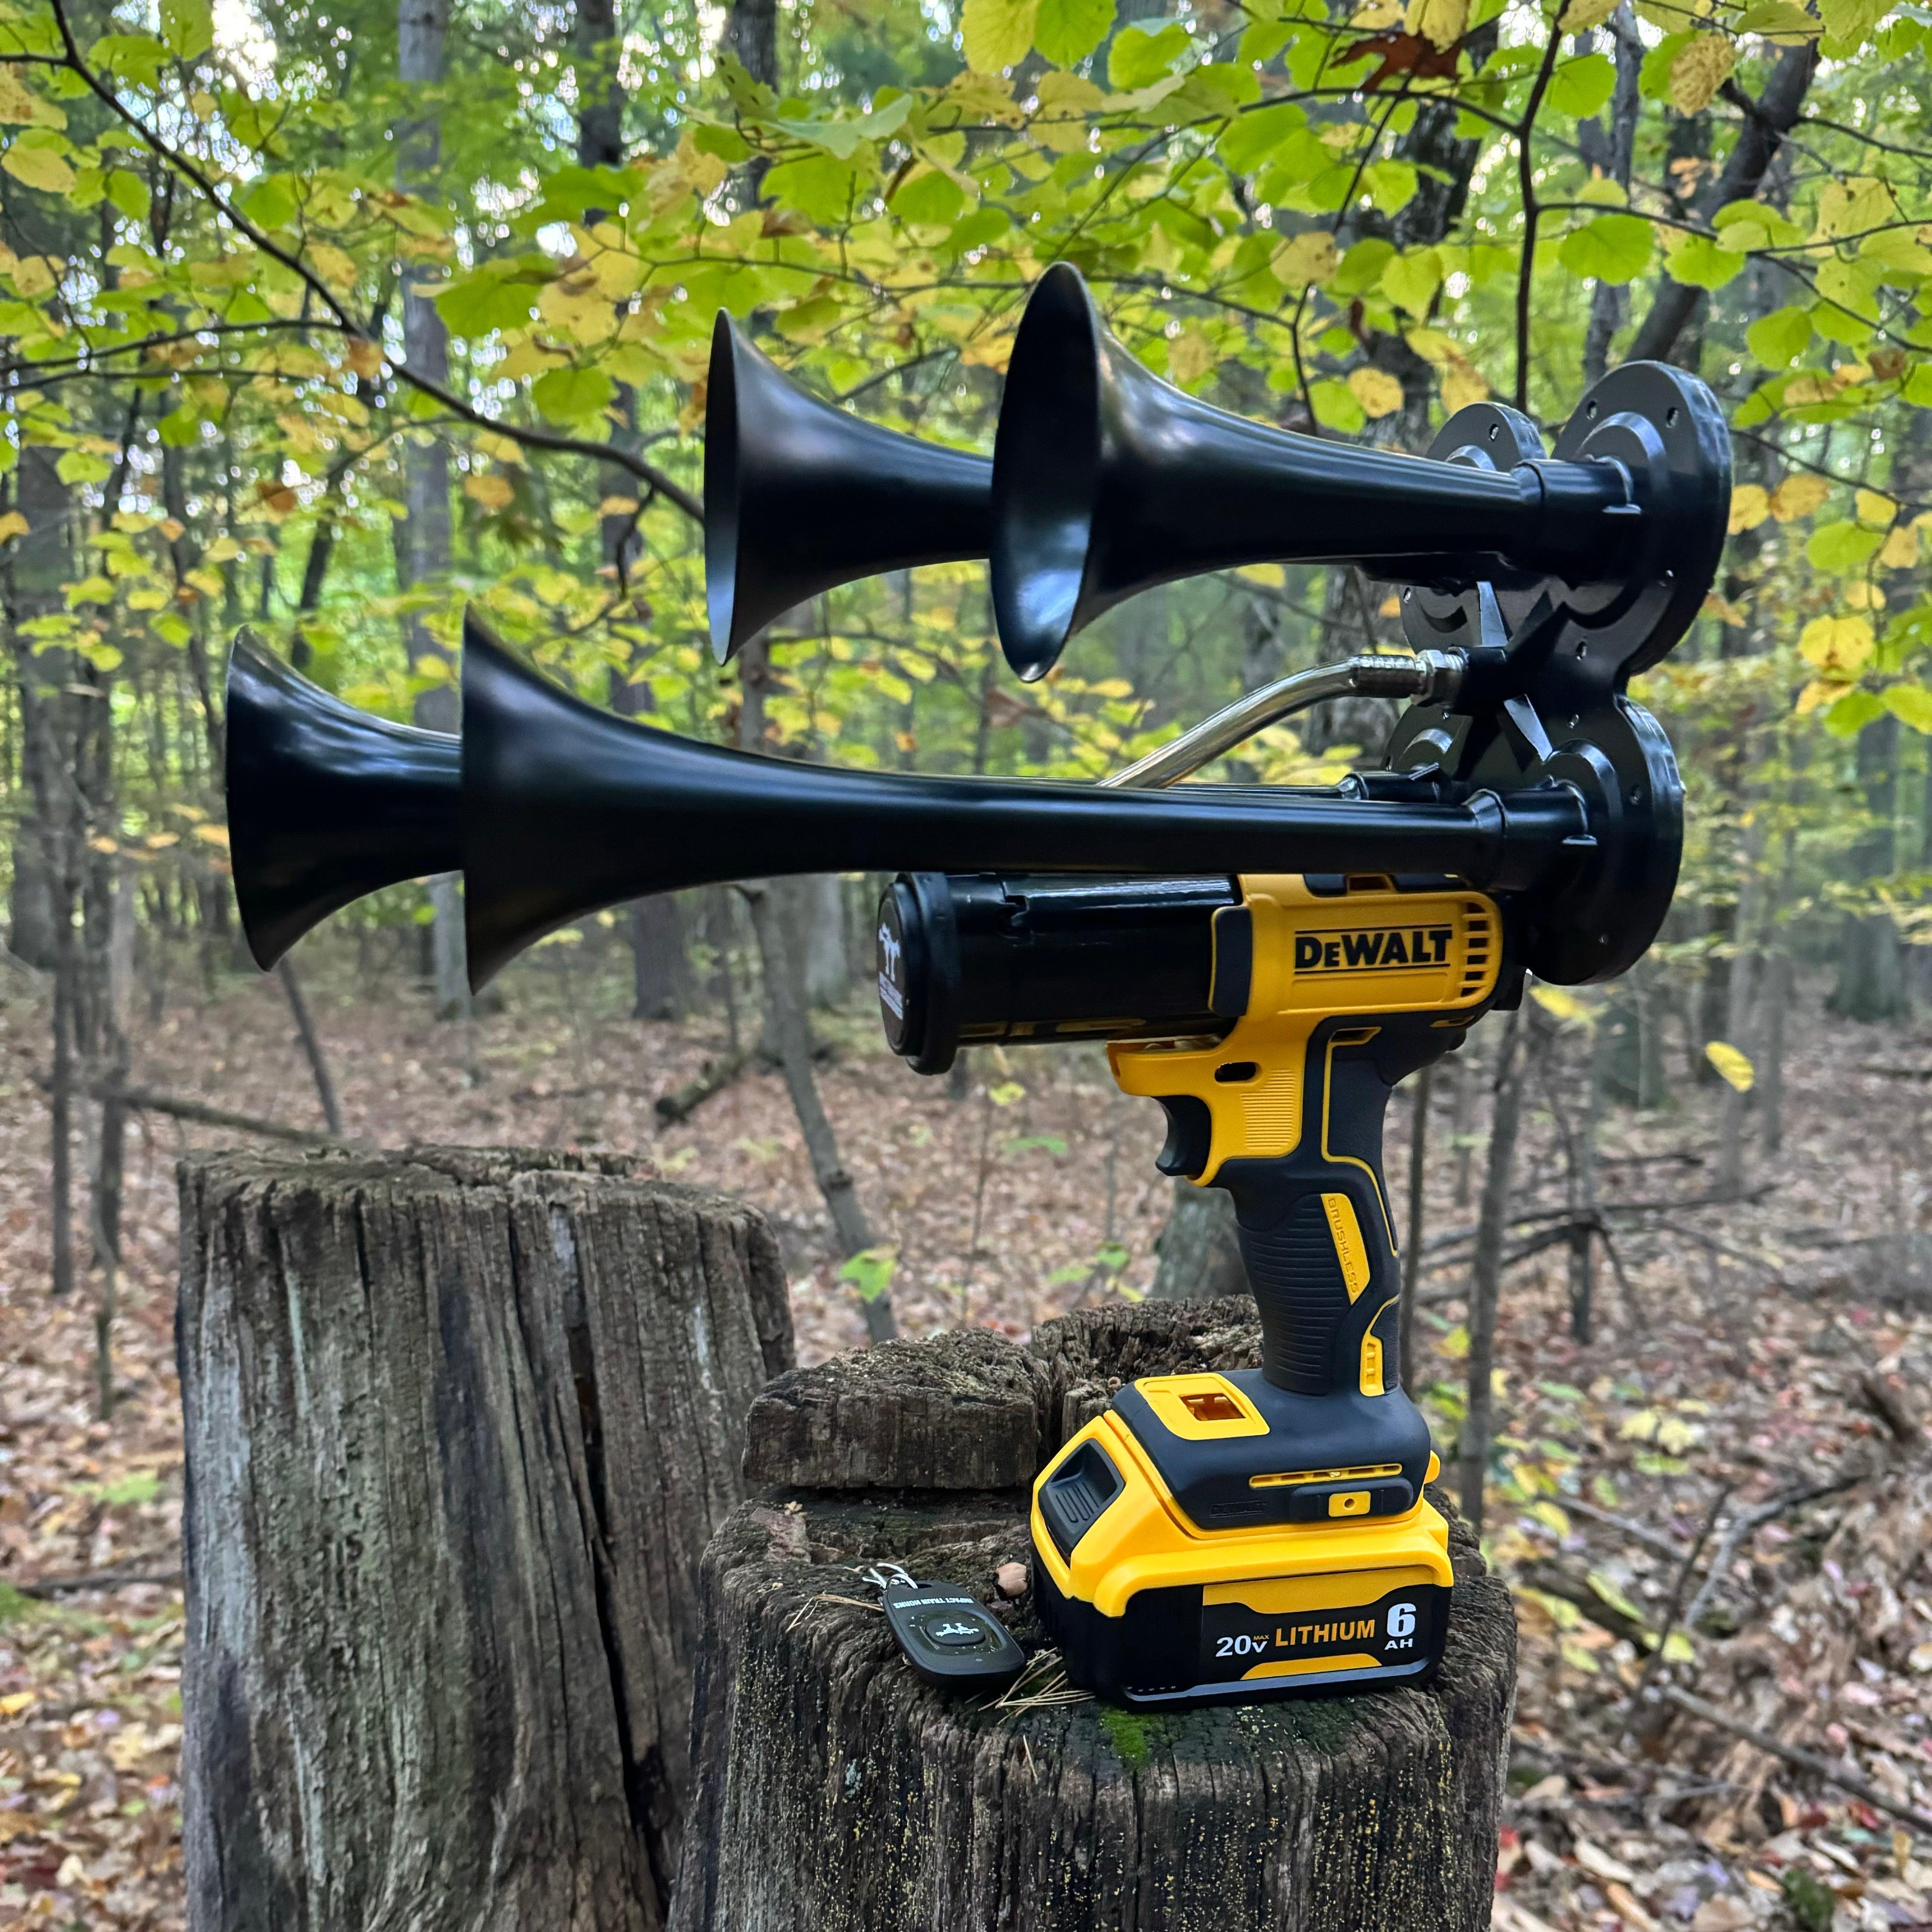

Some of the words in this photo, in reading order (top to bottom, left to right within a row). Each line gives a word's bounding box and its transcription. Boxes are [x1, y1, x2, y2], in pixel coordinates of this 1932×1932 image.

[1328, 1198, 1359, 1293] BRUSHLESS
[893, 1600, 921, 1609] HORNS
[1275, 1619, 1375, 1646] LITHIUM
[1387, 1603, 1417, 1636] 6
[1385, 1638, 1413, 1650] AH
